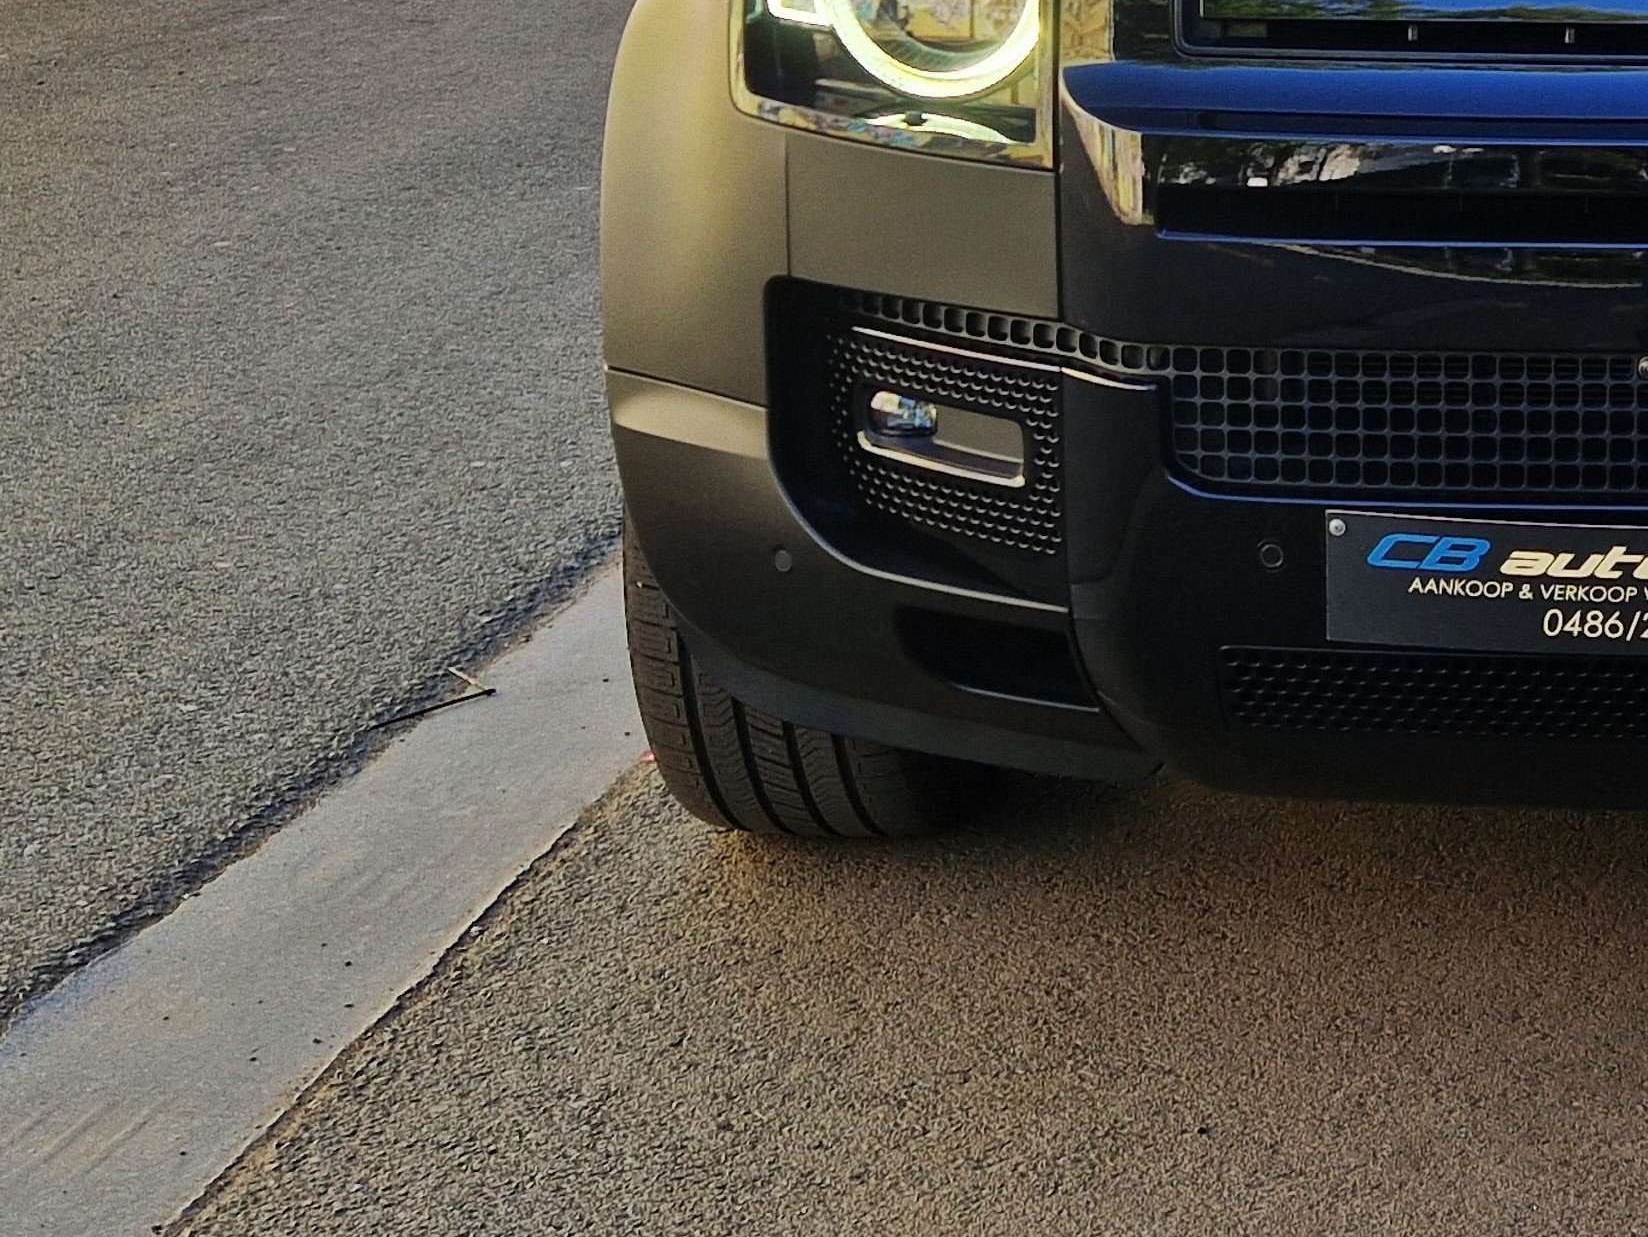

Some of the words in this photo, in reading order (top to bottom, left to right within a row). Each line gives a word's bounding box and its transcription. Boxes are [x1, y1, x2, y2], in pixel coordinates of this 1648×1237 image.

[1367, 533, 1491, 571] CB
[1407, 576, 1514, 598] AANKOOP
[1518, 583, 1533, 600] &
[1540, 583, 1638, 603] VERKOOP
